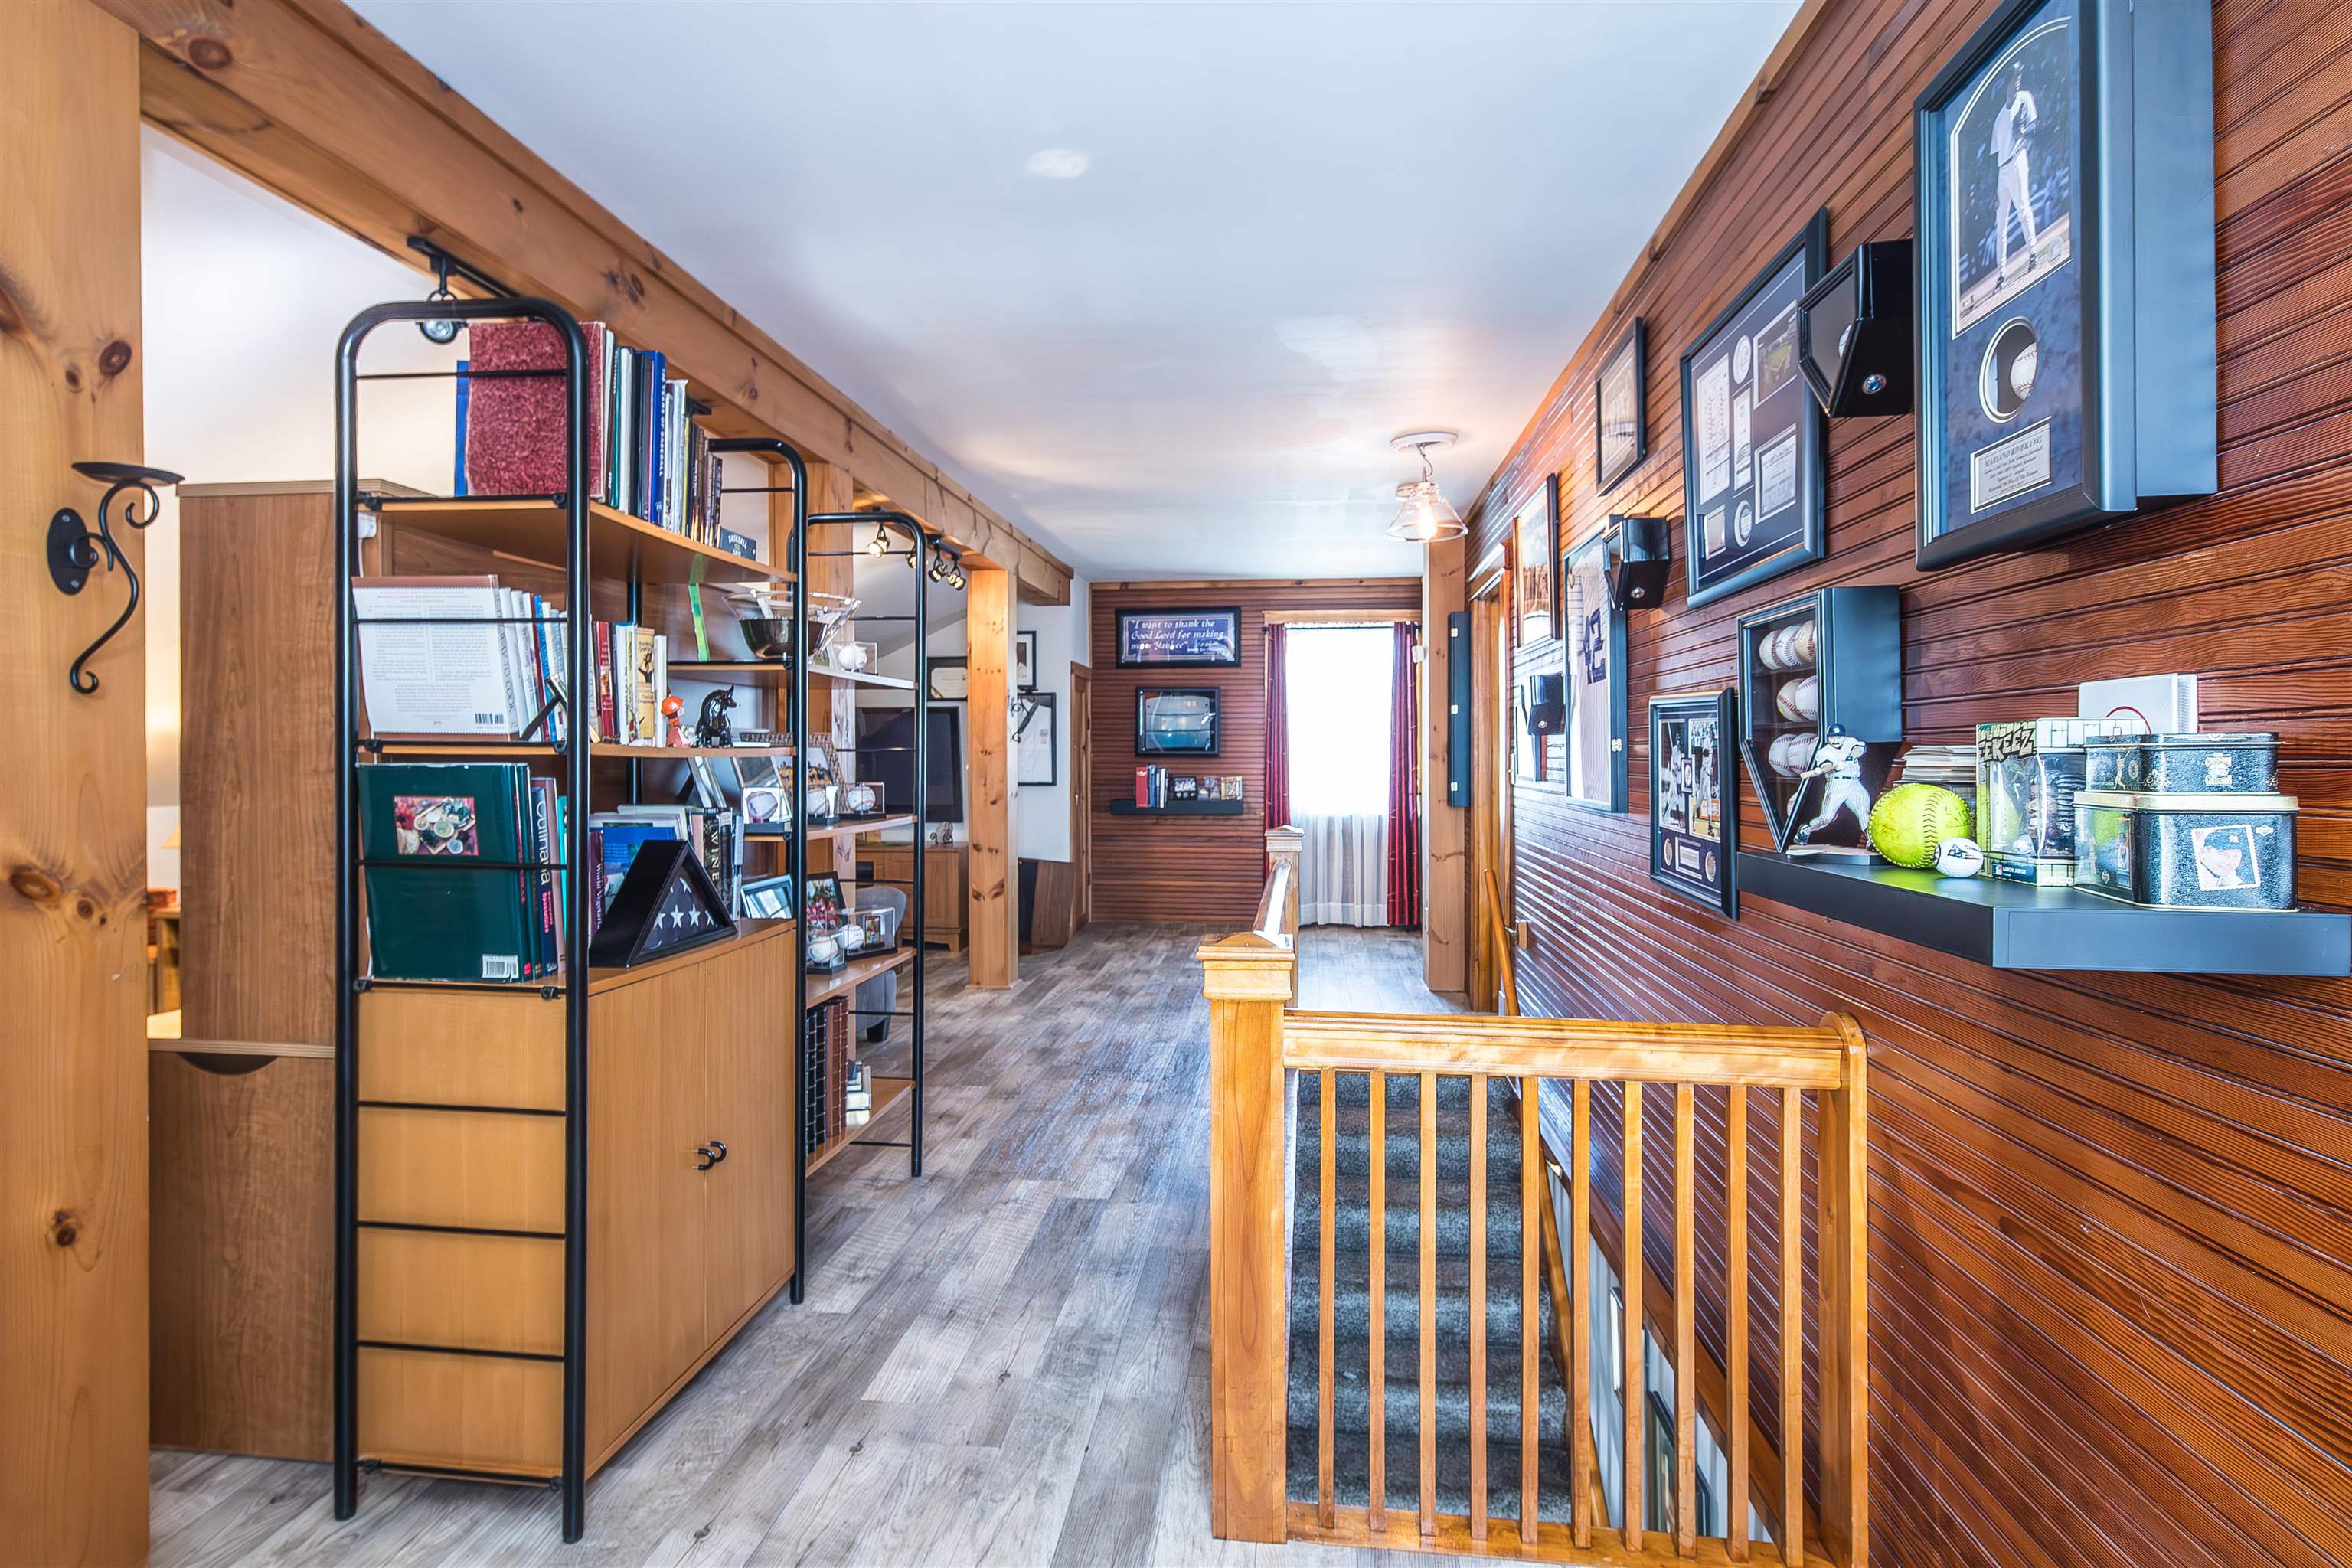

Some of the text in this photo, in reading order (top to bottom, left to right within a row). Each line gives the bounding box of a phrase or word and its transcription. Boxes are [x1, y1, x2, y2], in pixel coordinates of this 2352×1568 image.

[660, 416, 665, 429] OF
[1174, 619, 1199, 628] thank
[1200, 618, 1216, 627] the
[1131, 629, 1224, 640] Good Lord for making
[500, 632, 514, 713] WAY TO COOK
[711, 830, 720, 882] WINE
